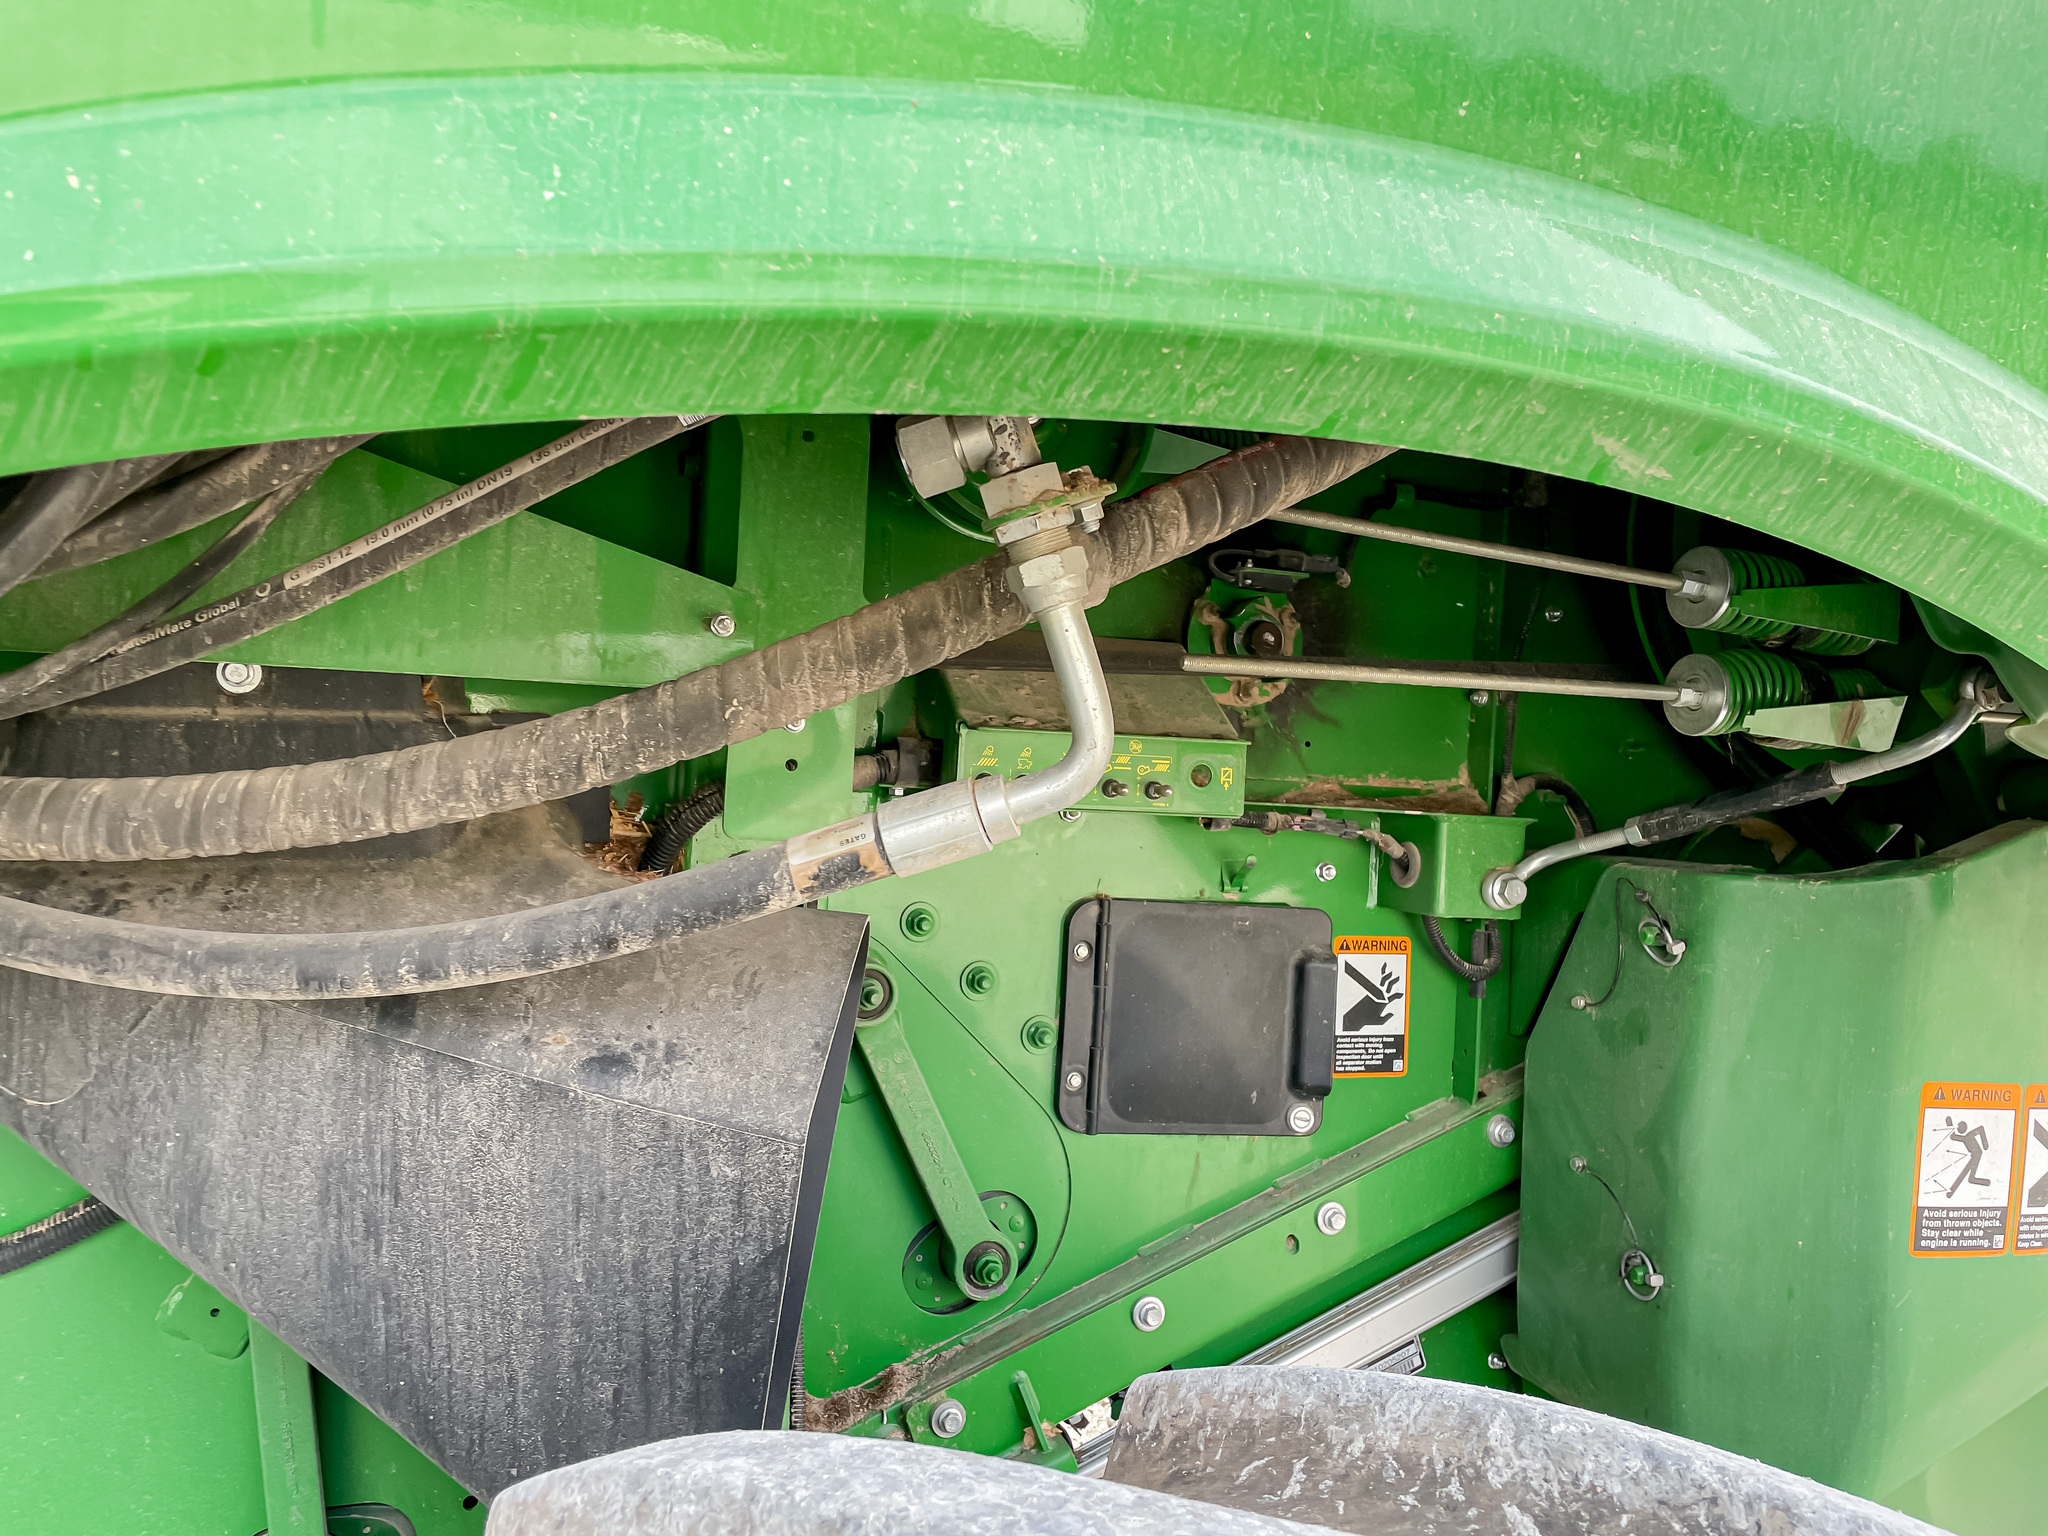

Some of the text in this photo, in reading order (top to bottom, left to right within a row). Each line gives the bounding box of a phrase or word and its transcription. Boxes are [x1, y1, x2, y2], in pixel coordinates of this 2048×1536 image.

[363, 527, 389, 546] 19.0
[394, 516, 418, 533] mm
[422, 498, 453, 519] (0.75
[457, 487, 473, 501] in)
[477, 466, 513, 490] DN19
[554, 435, 576, 451] bar
[194, 597, 241, 622] Global
[839, 833, 867, 846] GATES
[1352, 939, 1408, 951] WARNING
[1950, 1088, 2012, 1102] WARNING
[1923, 1209, 2001, 1219] Avoid serious injury
[1922, 1219, 2002, 1228] from thrown objects.
[1921, 1228, 1984, 1239] Stay clear while
[1920, 1238, 1991, 1248] engine is running.
[2017, 1241, 2029, 1249] Keep
